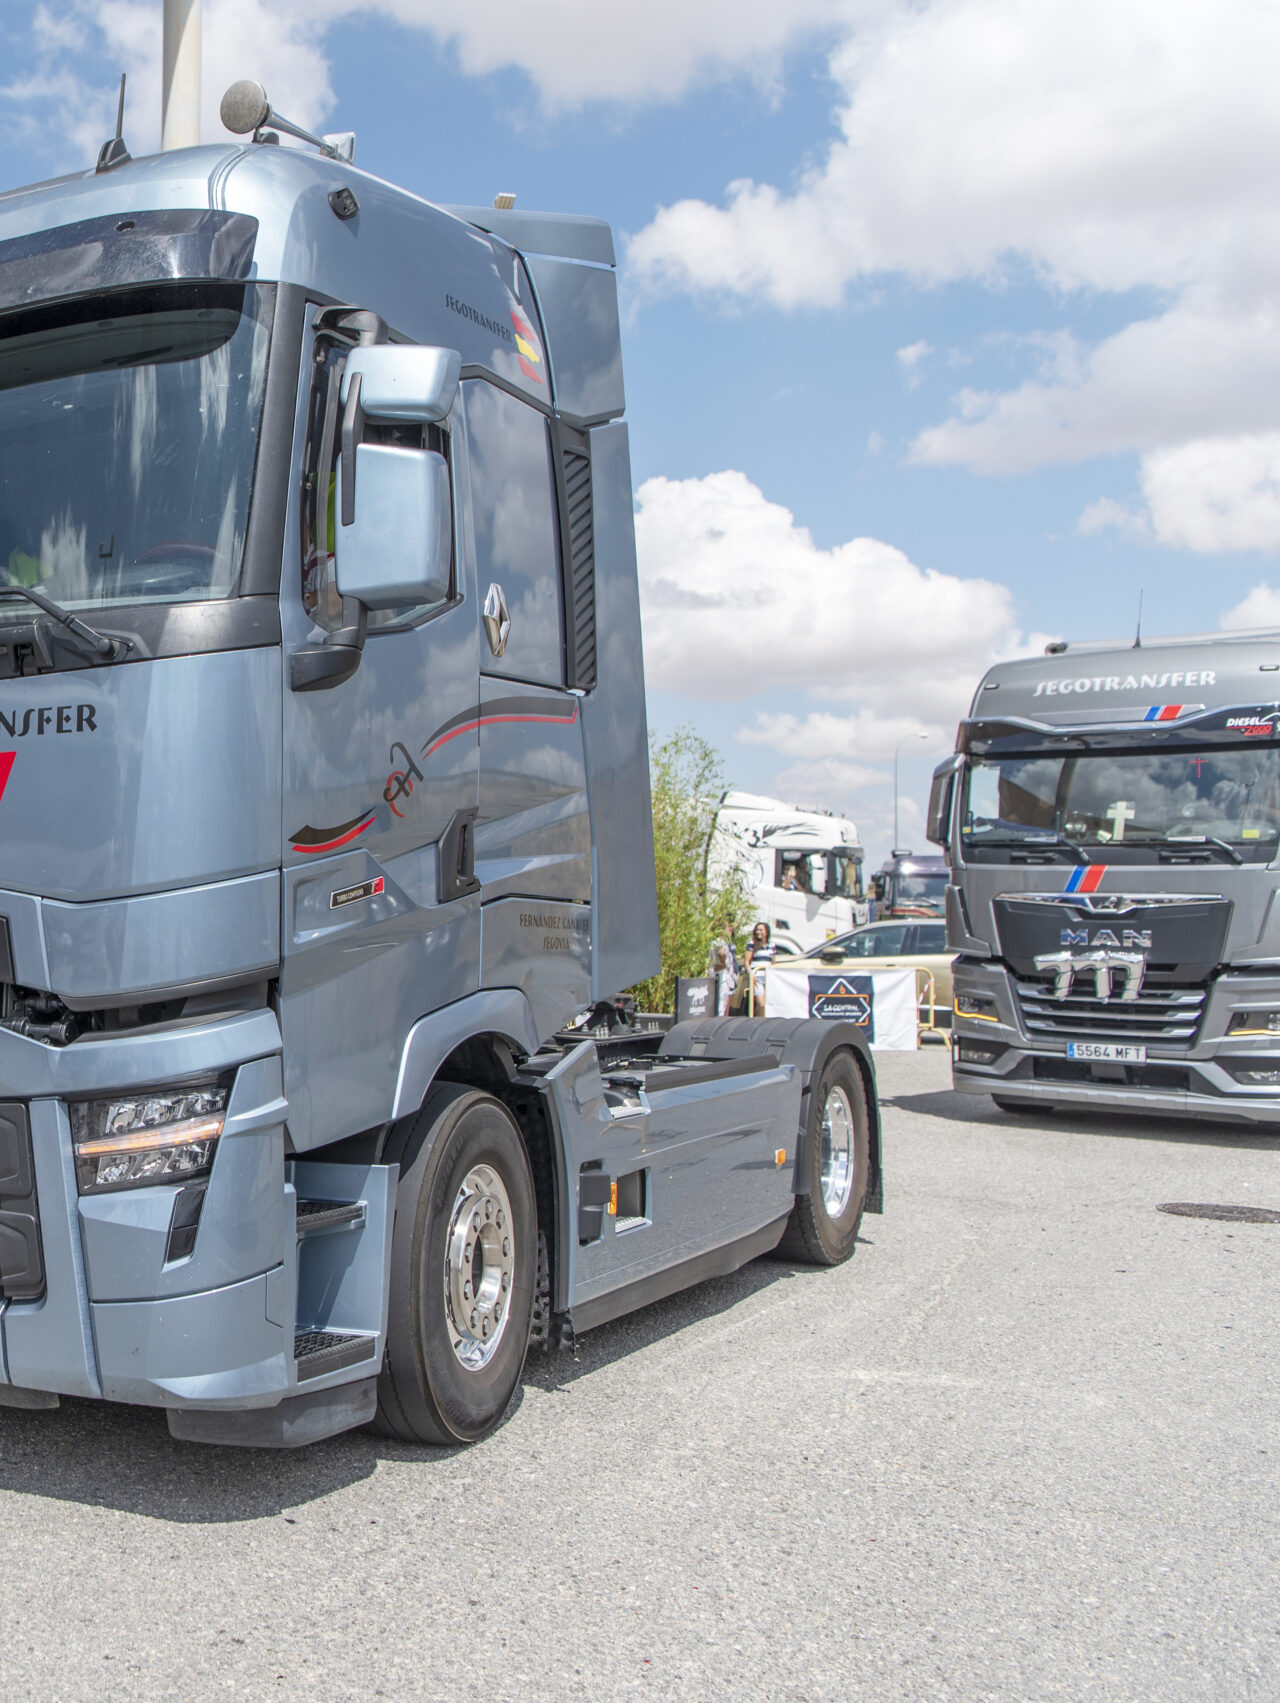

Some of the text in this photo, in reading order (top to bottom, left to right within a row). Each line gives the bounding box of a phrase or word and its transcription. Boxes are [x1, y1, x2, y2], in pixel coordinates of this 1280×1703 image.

[445, 294, 512, 343] SEGOTRANSFER
[1032, 670, 1217, 697] SEGOTRANSFER
[1226, 716, 1261, 727] DIESEL
[1243, 725, 1273, 736] 2000
[519, 912, 561, 929] FERNANDEZ
[542, 935, 570, 950] SEGOVIA
[1060, 928, 1153, 948] MAN
[1076, 1044, 1142, 1060] 5564 MFT
